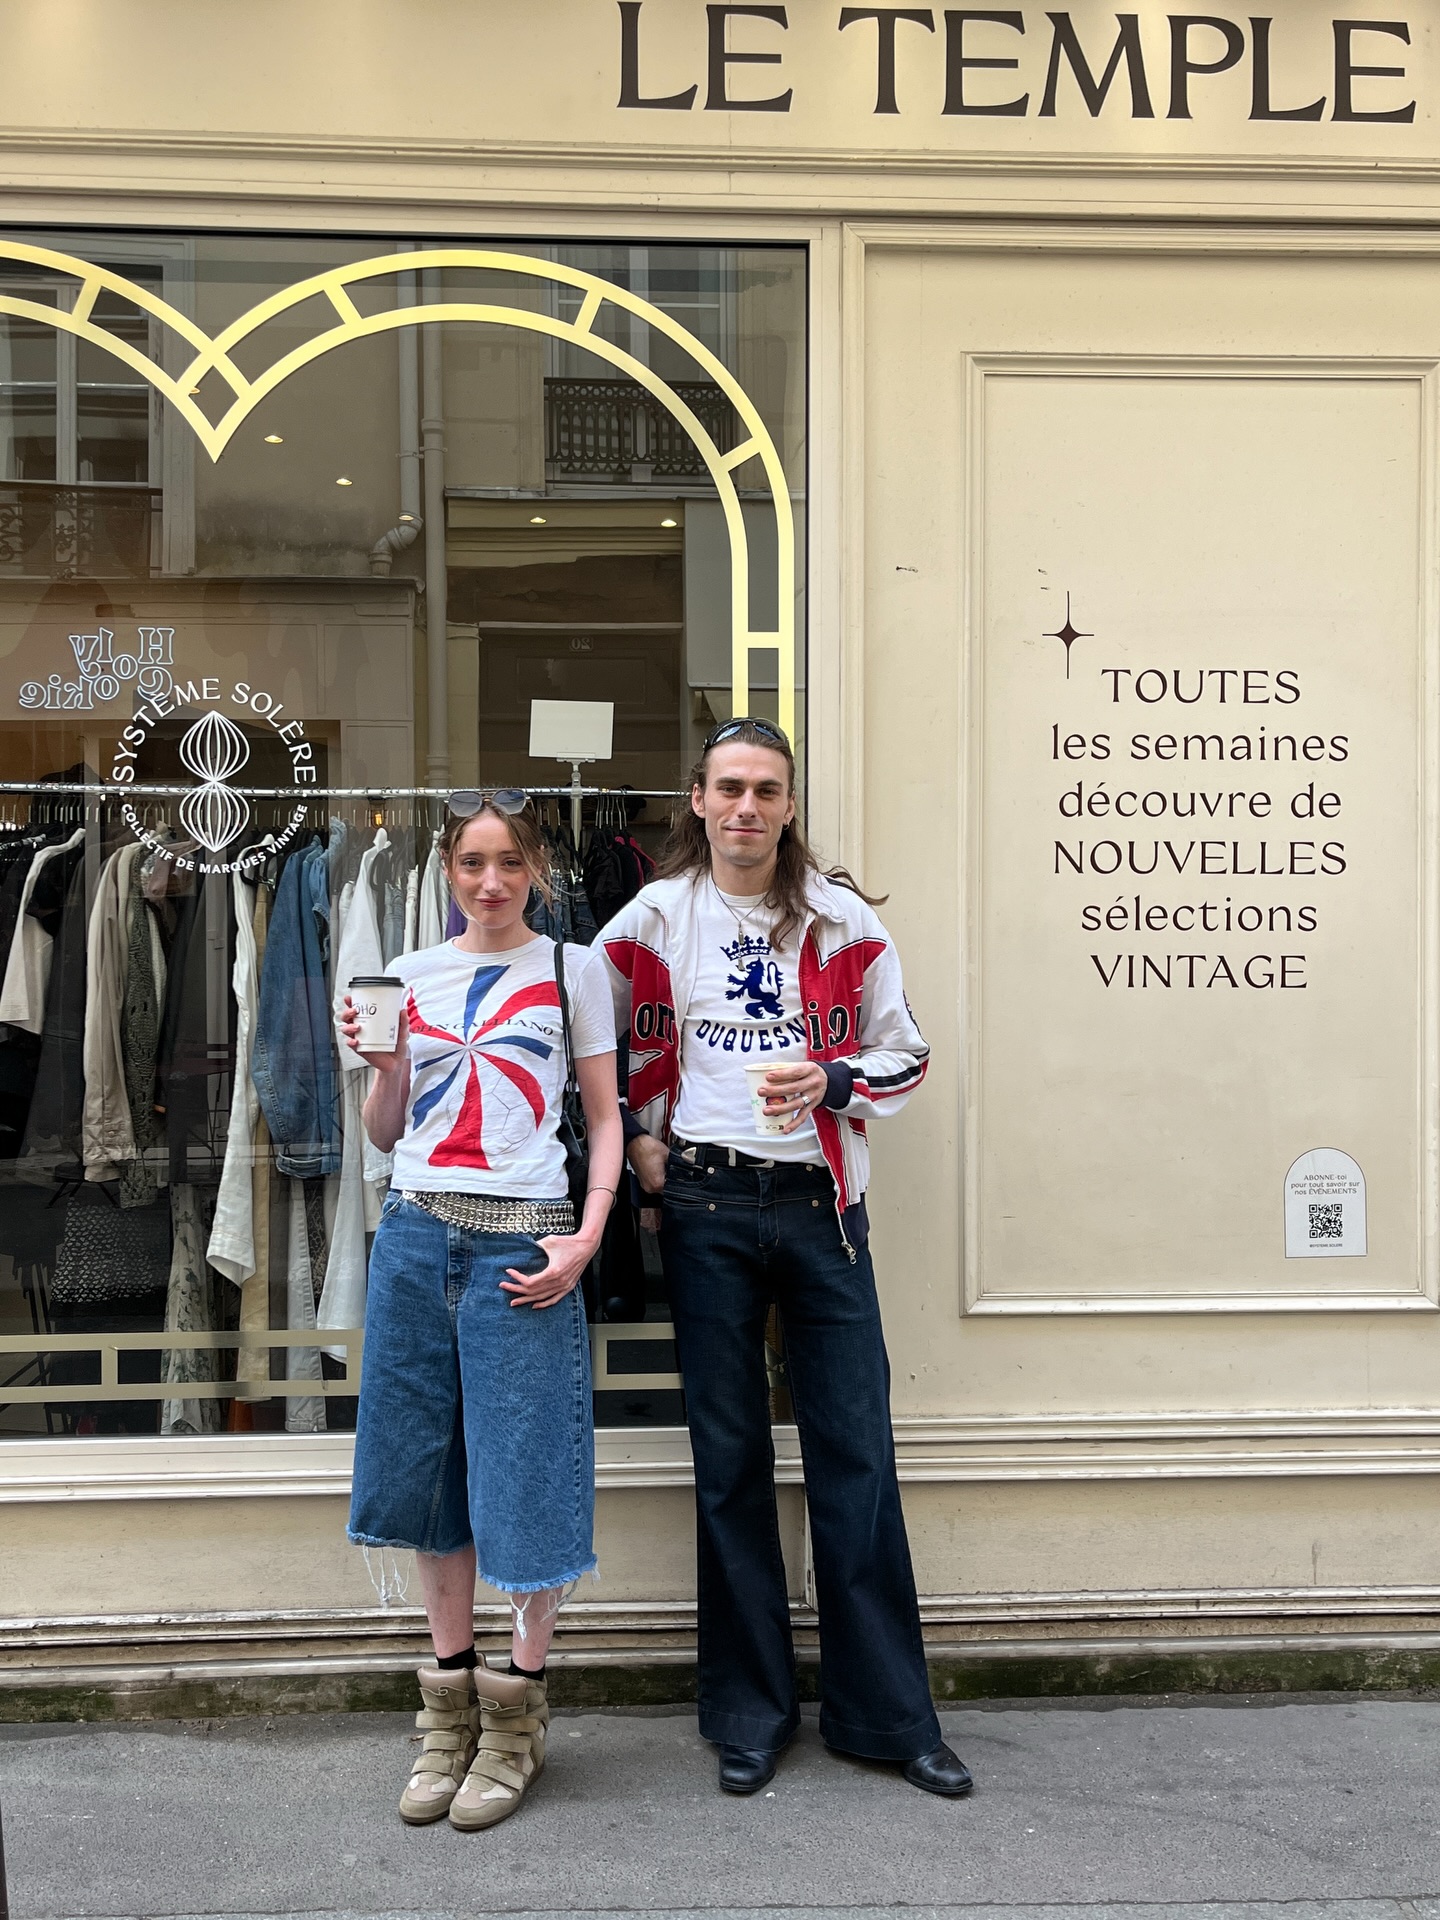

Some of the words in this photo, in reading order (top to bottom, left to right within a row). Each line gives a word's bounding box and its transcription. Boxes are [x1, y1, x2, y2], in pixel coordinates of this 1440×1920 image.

[616, 1, 794, 113] LE
[838, 7, 1417, 124] TEMPLE
[1100, 668, 1301, 704] TOUTES
[231, 682, 317, 784] SOLÈRE
[1052, 723, 1111, 760] les
[1130, 726, 1349, 762] semaines
[1058, 781, 1272, 818] découvre
[1290, 781, 1342, 819] de
[121, 803, 174, 862] COLLECTIF
[175, 856, 196, 872] DE
[199, 853, 268, 874] MARQUES
[266, 804, 309, 855] VINTAGE
[1054, 840, 1347, 876] NOUVELLES
[1081, 894, 1318, 932] sélections
[1090, 954, 1308, 989] VINTAGE
[453, 1018, 554, 1036] GALLIANO
[696, 1014, 806, 1052] DUQUESN
